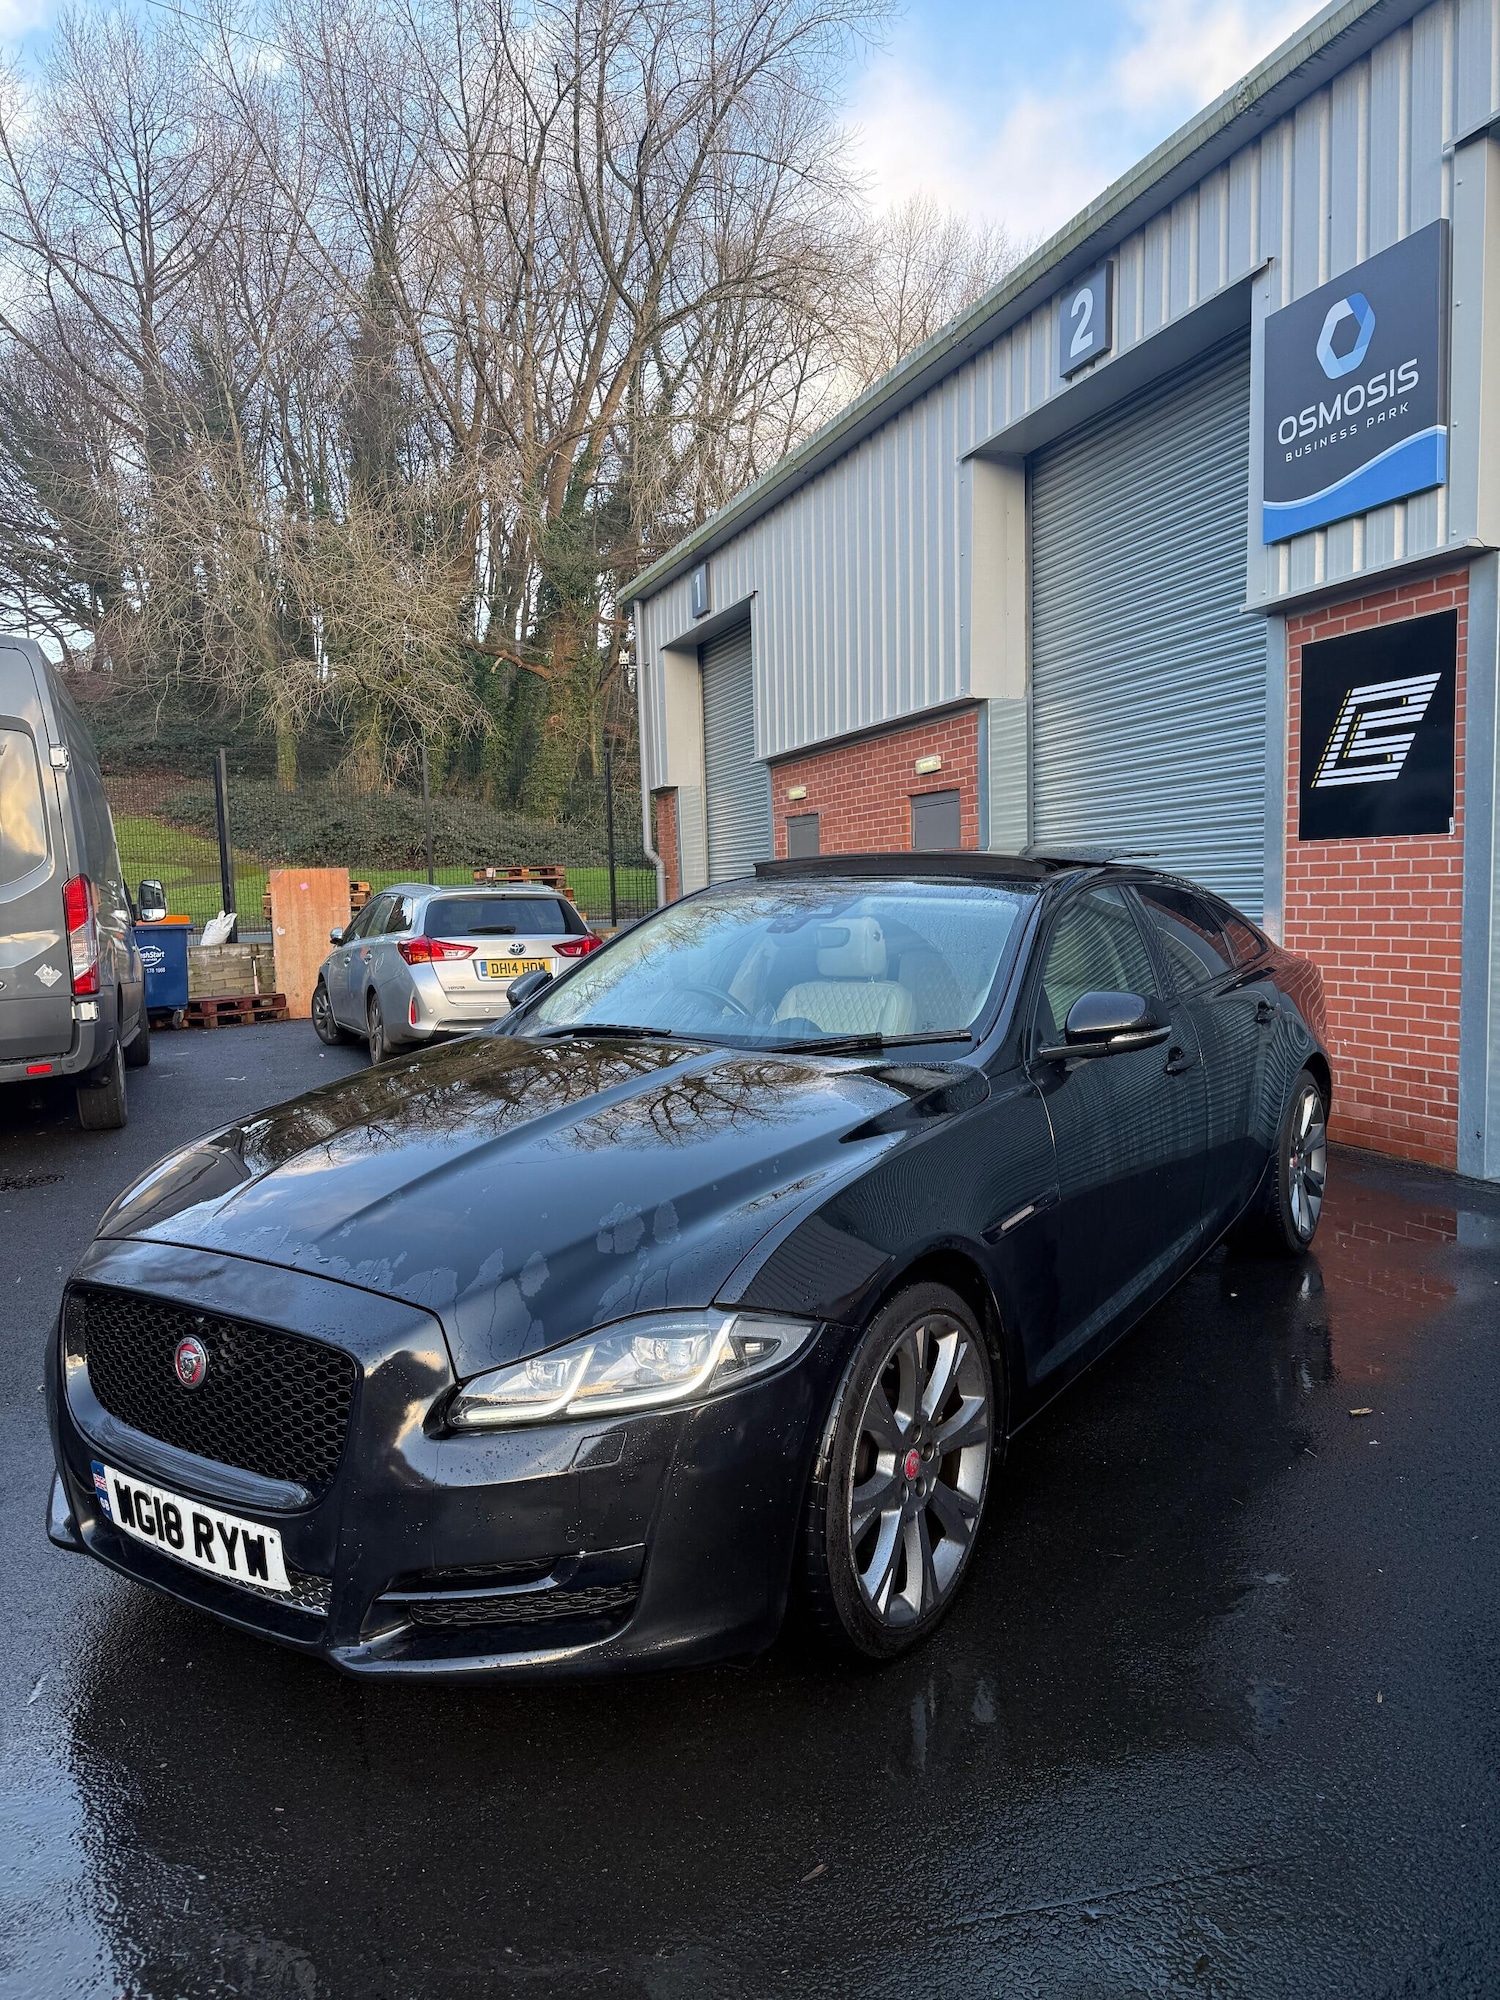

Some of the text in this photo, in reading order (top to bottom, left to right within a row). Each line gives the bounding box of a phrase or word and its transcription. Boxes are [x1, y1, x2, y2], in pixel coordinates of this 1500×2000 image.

[1070, 287, 1094, 359] 2
[1277, 358, 1420, 445] OSMOSIS
[1285, 401, 1410, 463] BUSINESS PARK
[694, 573, 701, 608] 1
[491, 962, 519, 974] DH14
[114, 1478, 269, 1582] WG18 RYW
